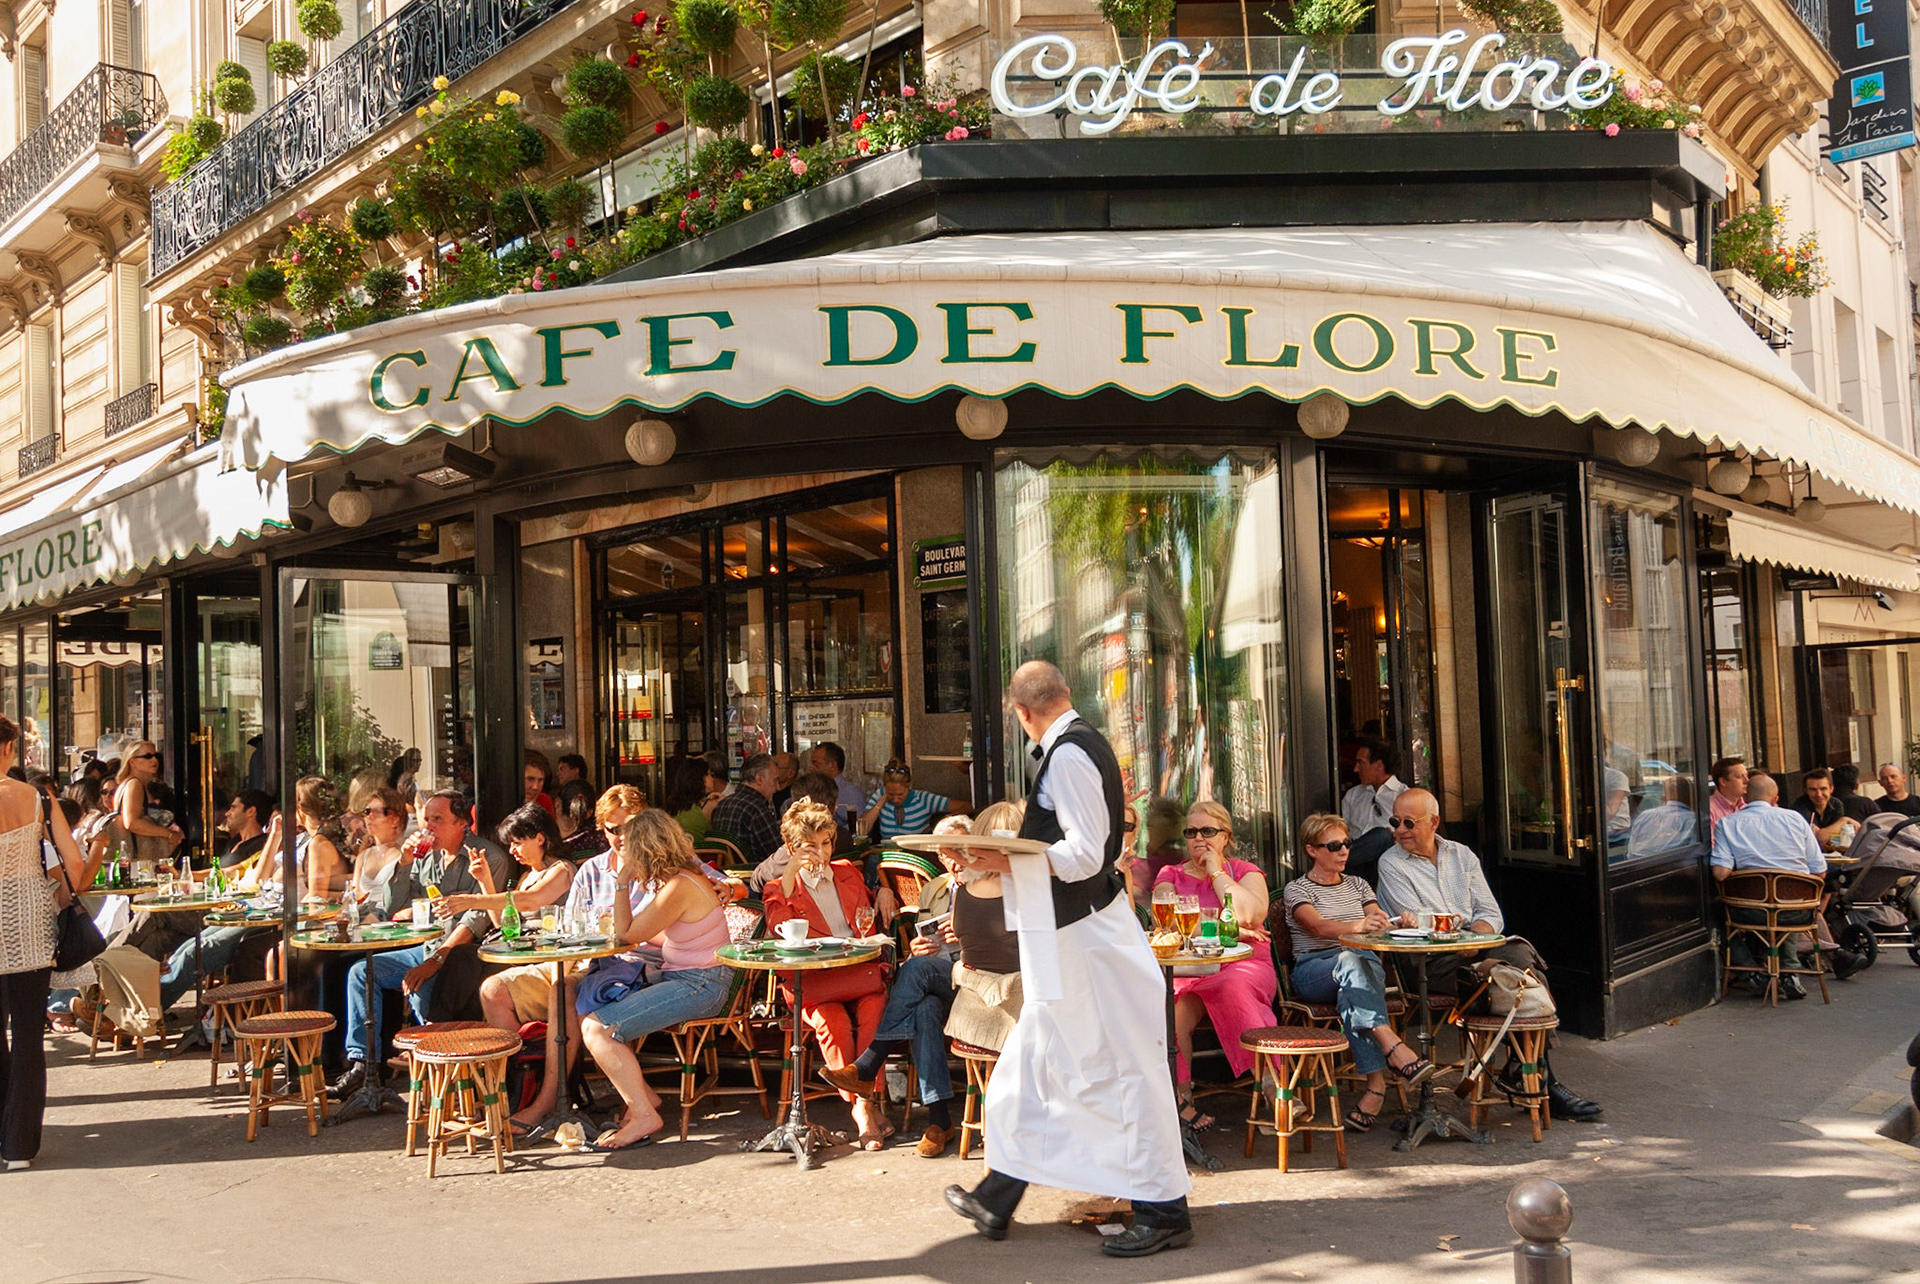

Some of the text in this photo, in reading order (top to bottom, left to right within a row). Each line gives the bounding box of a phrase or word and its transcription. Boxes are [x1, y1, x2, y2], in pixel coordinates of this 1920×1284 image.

[991, 28, 1614, 135] Café de Flore
[1835, 107, 1907, 135] Jardins
[1838, 121, 1904, 146] de Paris
[1841, 138, 1903, 160] ST GERMAIN
[369, 300, 1560, 413] CAFE DE FLORE
[0, 520, 103, 592] FLORE
[920, 560, 966, 577] SAINT GERM
